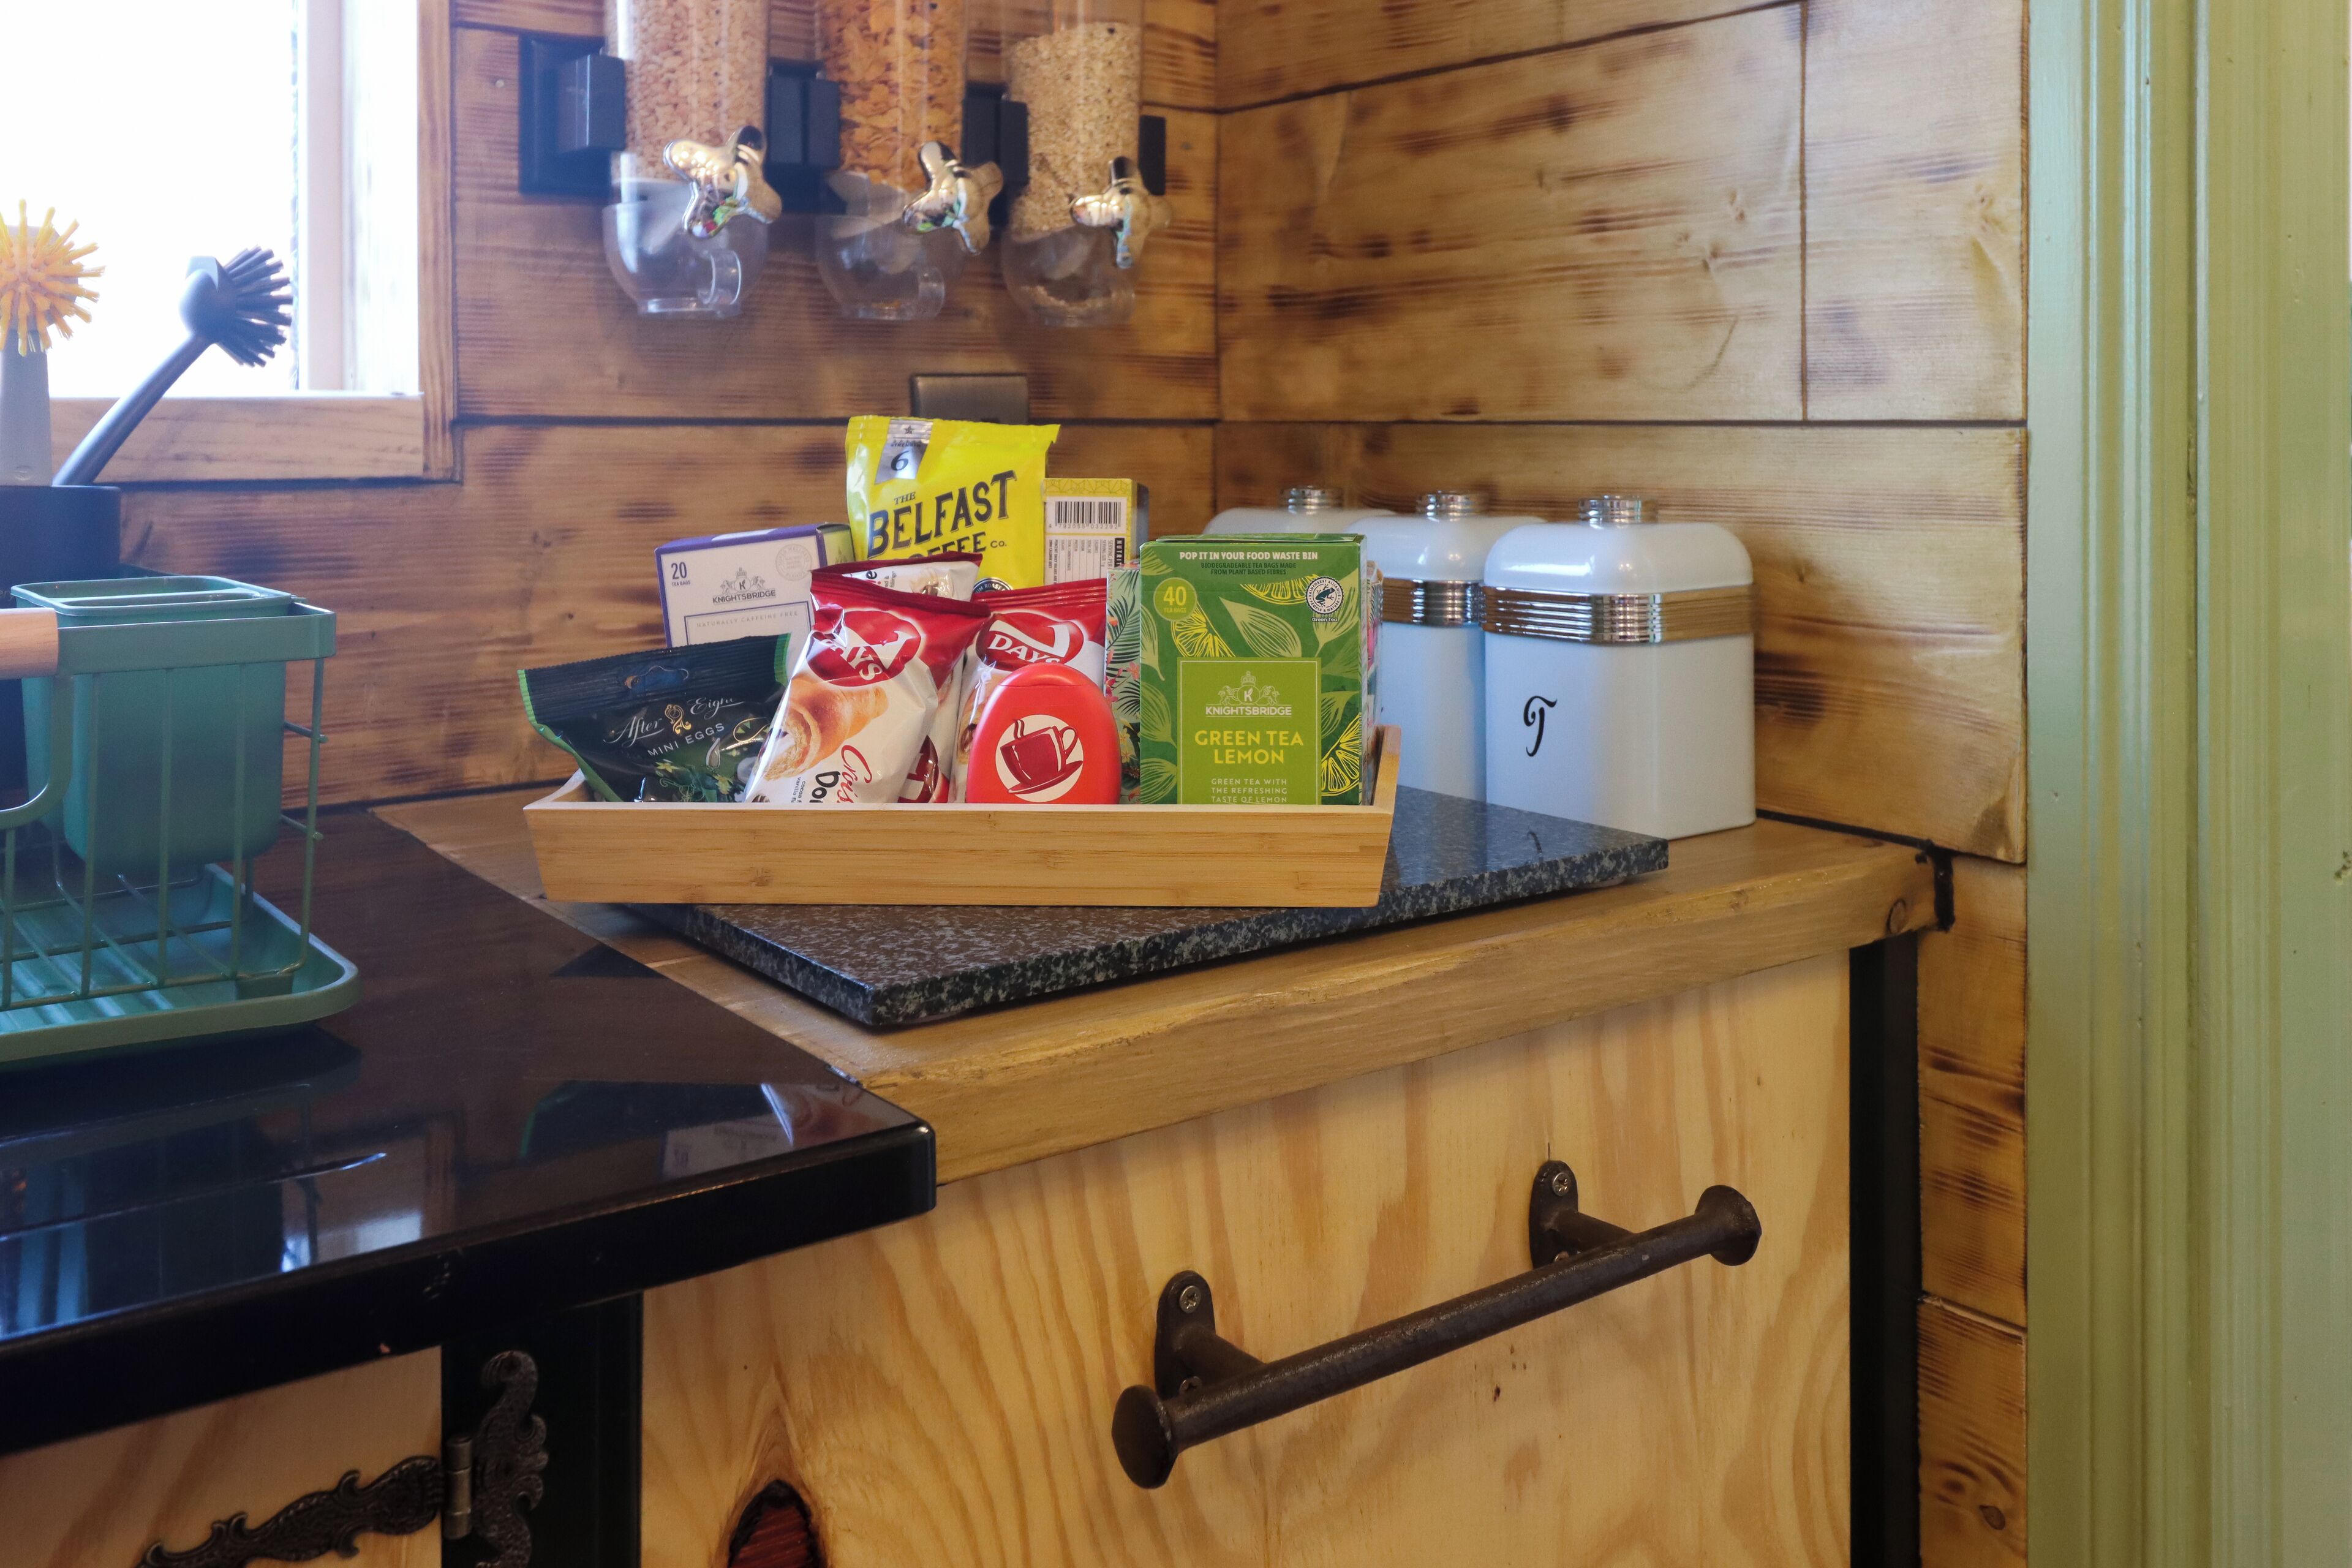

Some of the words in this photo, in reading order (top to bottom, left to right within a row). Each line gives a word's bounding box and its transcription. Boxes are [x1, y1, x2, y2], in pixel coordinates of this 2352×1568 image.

[891, 450, 910, 471] 6
[894, 492, 916, 505] THE
[867, 470, 1017, 559] BELFAST
[908, 531, 987, 559] FEE
[671, 562, 687, 579] 20
[712, 590, 775, 603] KNIGHTSBRIDGE
[1164, 586, 1186, 606] 40
[1308, 579, 1327, 597] RAINFOREST
[1328, 581, 1341, 597] ALLIANCE
[1310, 600, 1322, 612] PEOPLE
[1327, 600, 1340, 611] NATURE
[696, 617, 738, 628] NATURALLY
[741, 614, 776, 623] CAFFEINE
[1243, 687, 1253, 702] K
[1205, 706, 1292, 715] KNIGHTSBRIDGE
[603, 717, 665, 748] After
[647, 741, 679, 757] MINI
[685, 723, 725, 745] EGGS
[1194, 730, 1261, 745] GREEN
[1266, 731, 1303, 745] TEA
[1214, 749, 1284, 764] LEMON
[837, 744, 873, 803] Crois
[793, 777, 801, 796] vanilla
